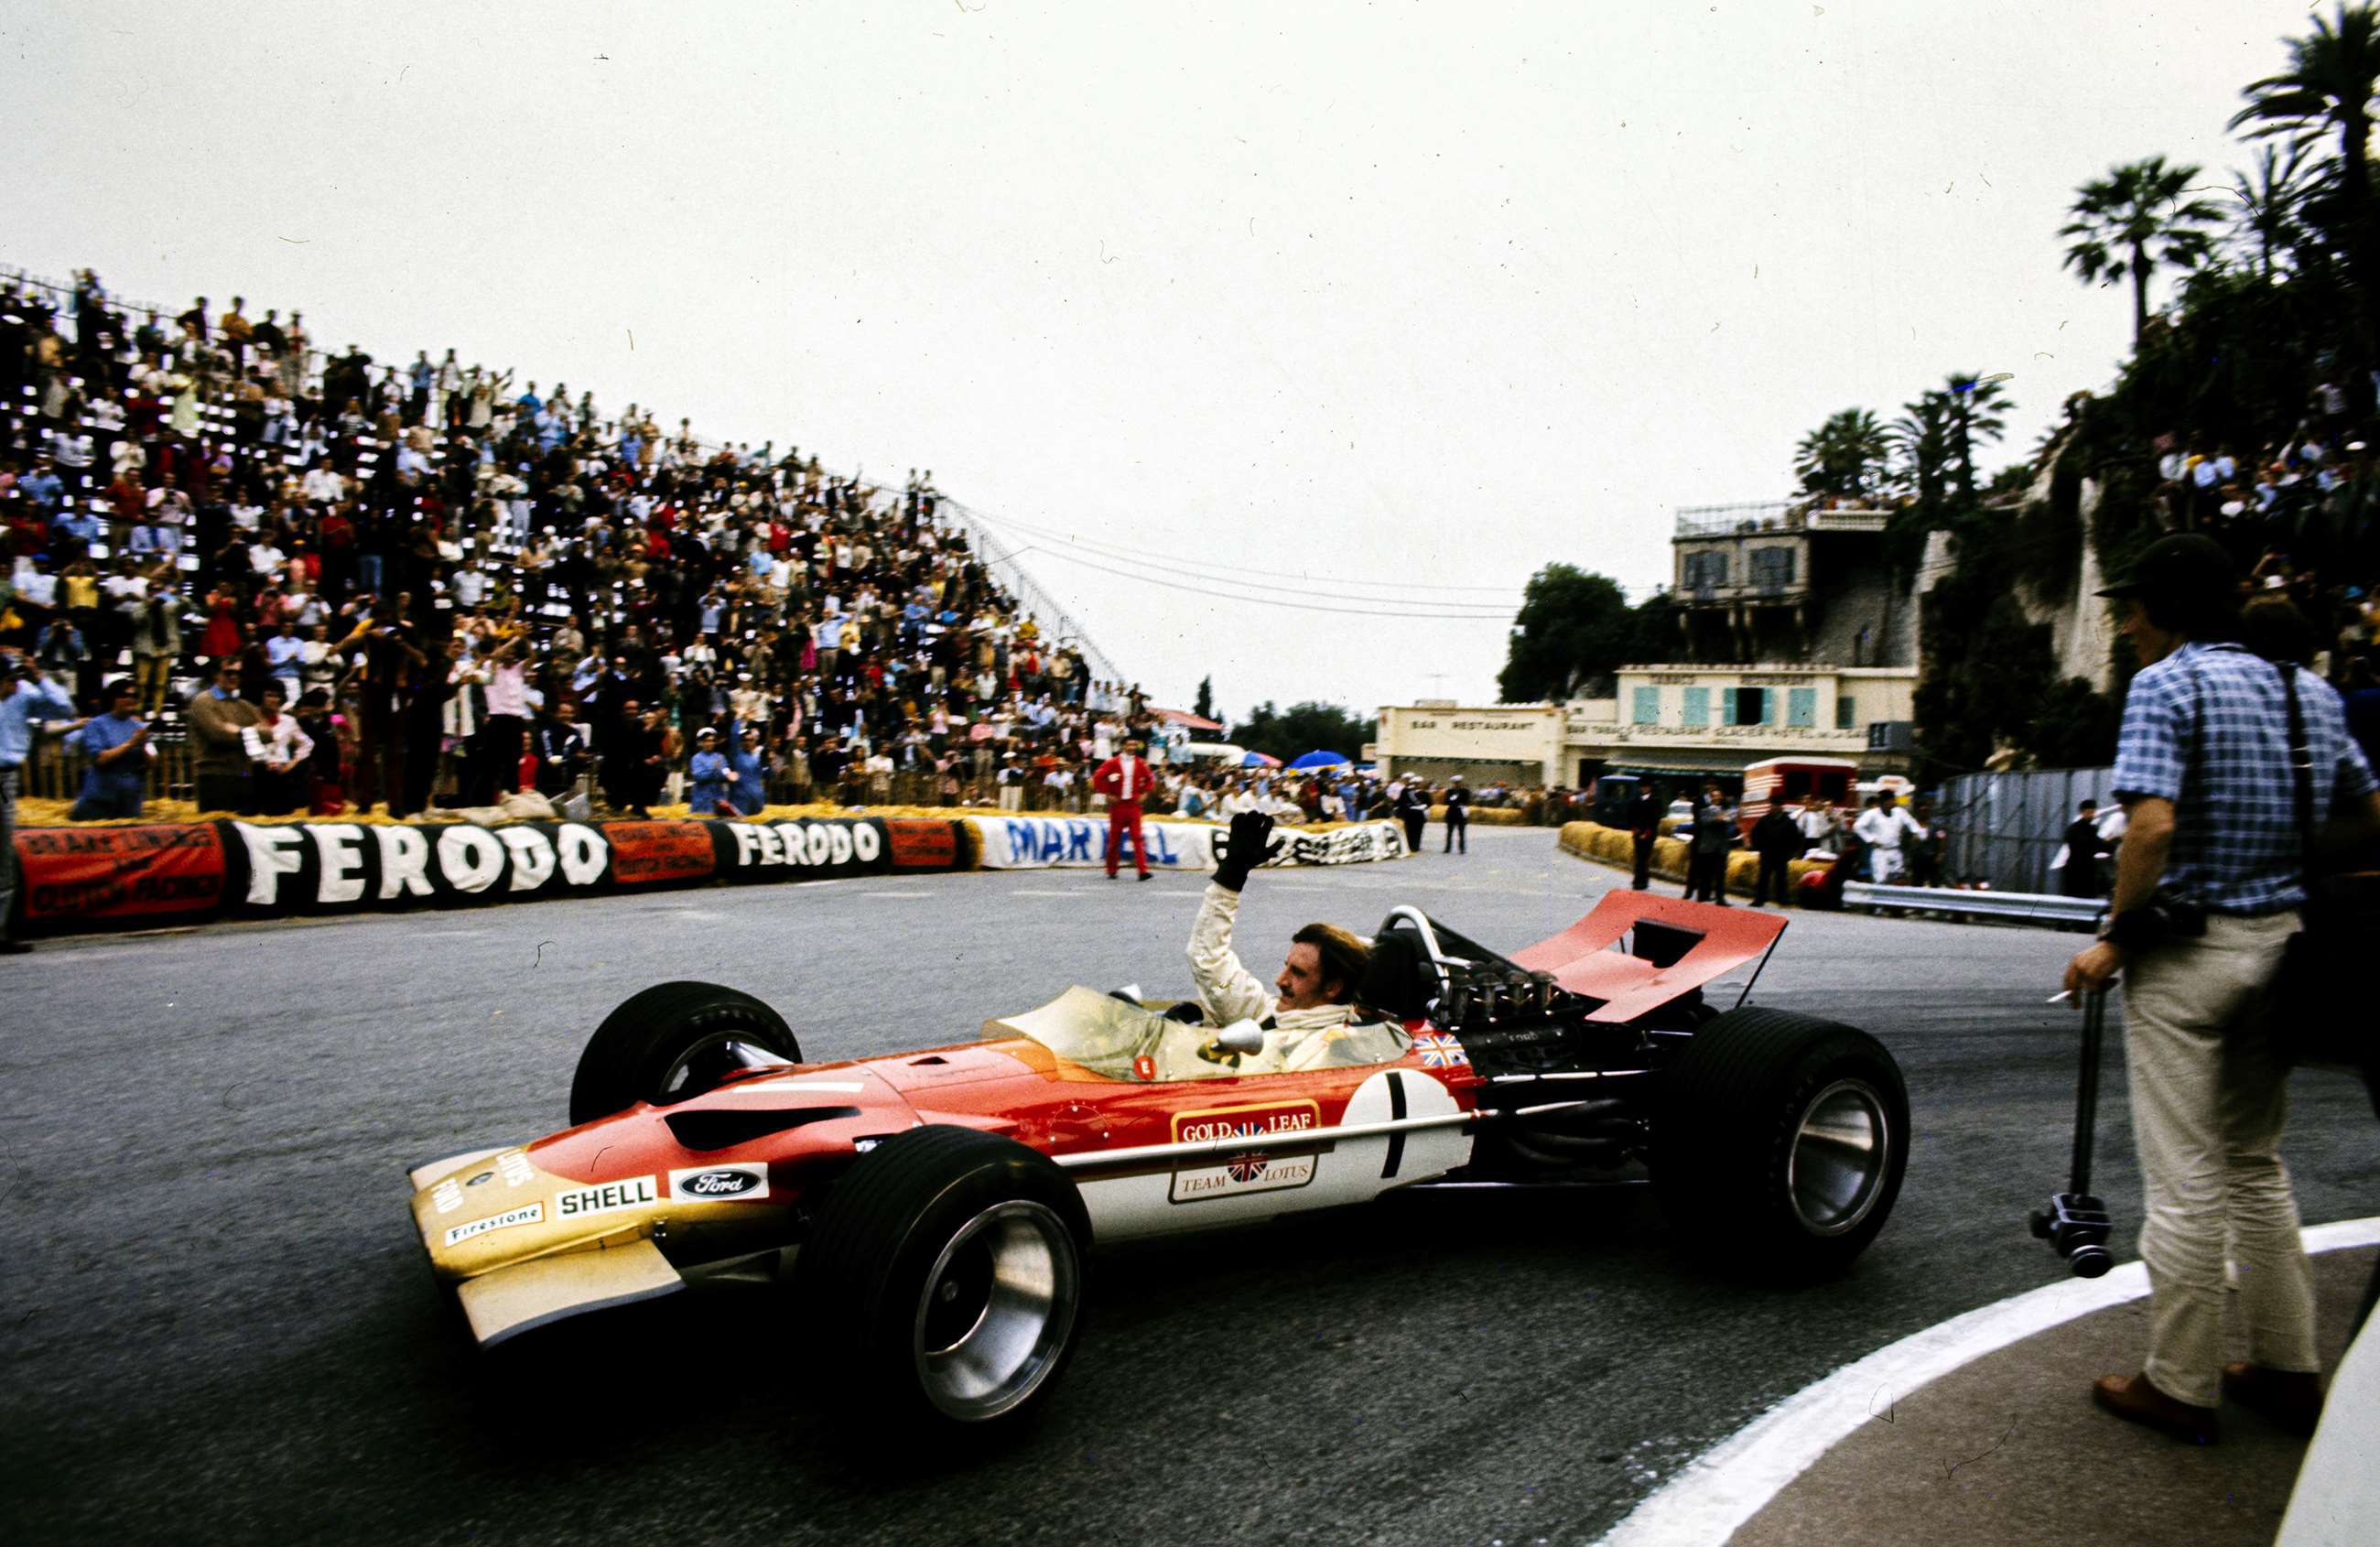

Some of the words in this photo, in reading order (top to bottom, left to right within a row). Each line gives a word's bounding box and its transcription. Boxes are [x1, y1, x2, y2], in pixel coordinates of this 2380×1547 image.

[1412, 720, 1437, 730] BAR
[1452, 720, 1536, 730] RESTAURANT
[727, 822, 880, 866] FERODO
[233, 823, 608, 904] FERODO
[1183, 1121, 1232, 1143] GOLD
[1269, 1112, 1312, 1132] LEAF
[1380, 1071, 1408, 1179] 1
[693, 1173, 744, 1195] Ford
[1182, 1176, 1227, 1193] TEAM
[1263, 1163, 1309, 1183] LOTUS
[561, 1182, 654, 1216] SHELL
[451, 1209, 538, 1241] Firestone
